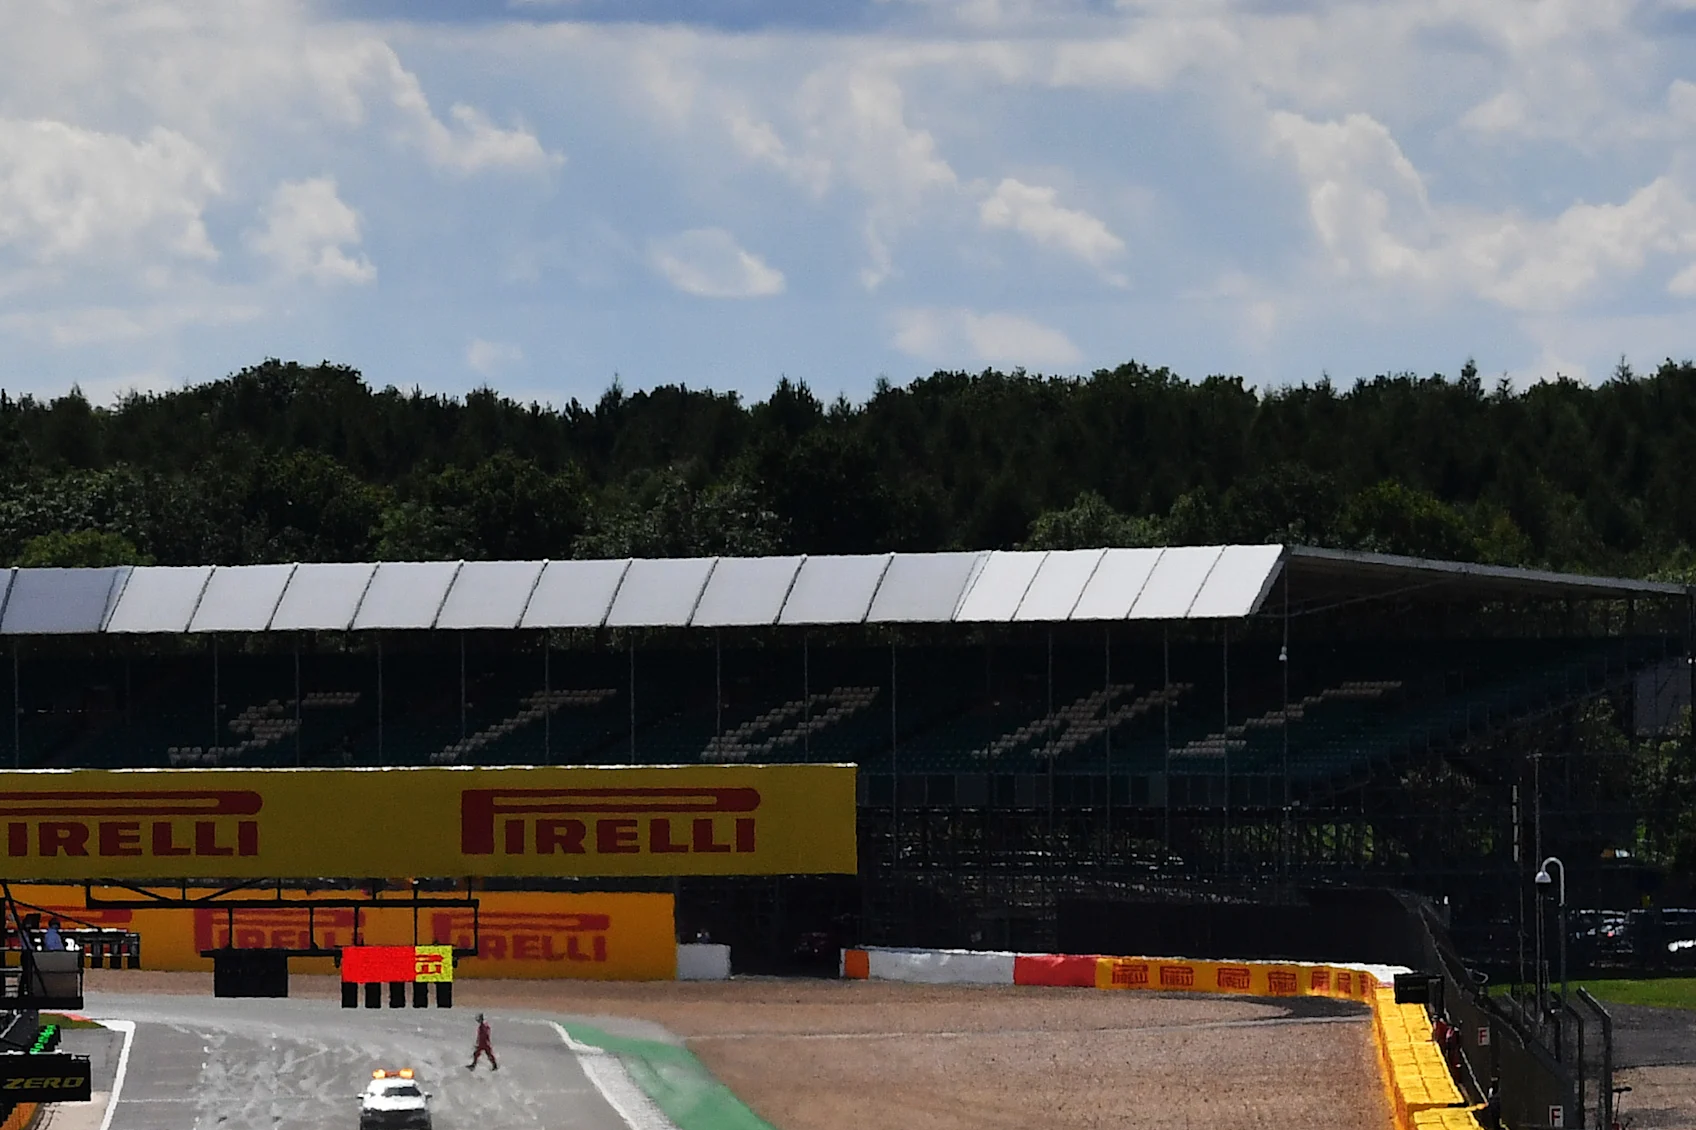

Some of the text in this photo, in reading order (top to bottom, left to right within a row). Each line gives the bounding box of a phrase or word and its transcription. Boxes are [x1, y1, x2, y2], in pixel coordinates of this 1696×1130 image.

[461, 787, 761, 855] PIRELLI
[1479, 1028, 1488, 1044] F
[2, 1076, 85, 1090] ZERO
[1550, 1108, 1560, 1125] F
